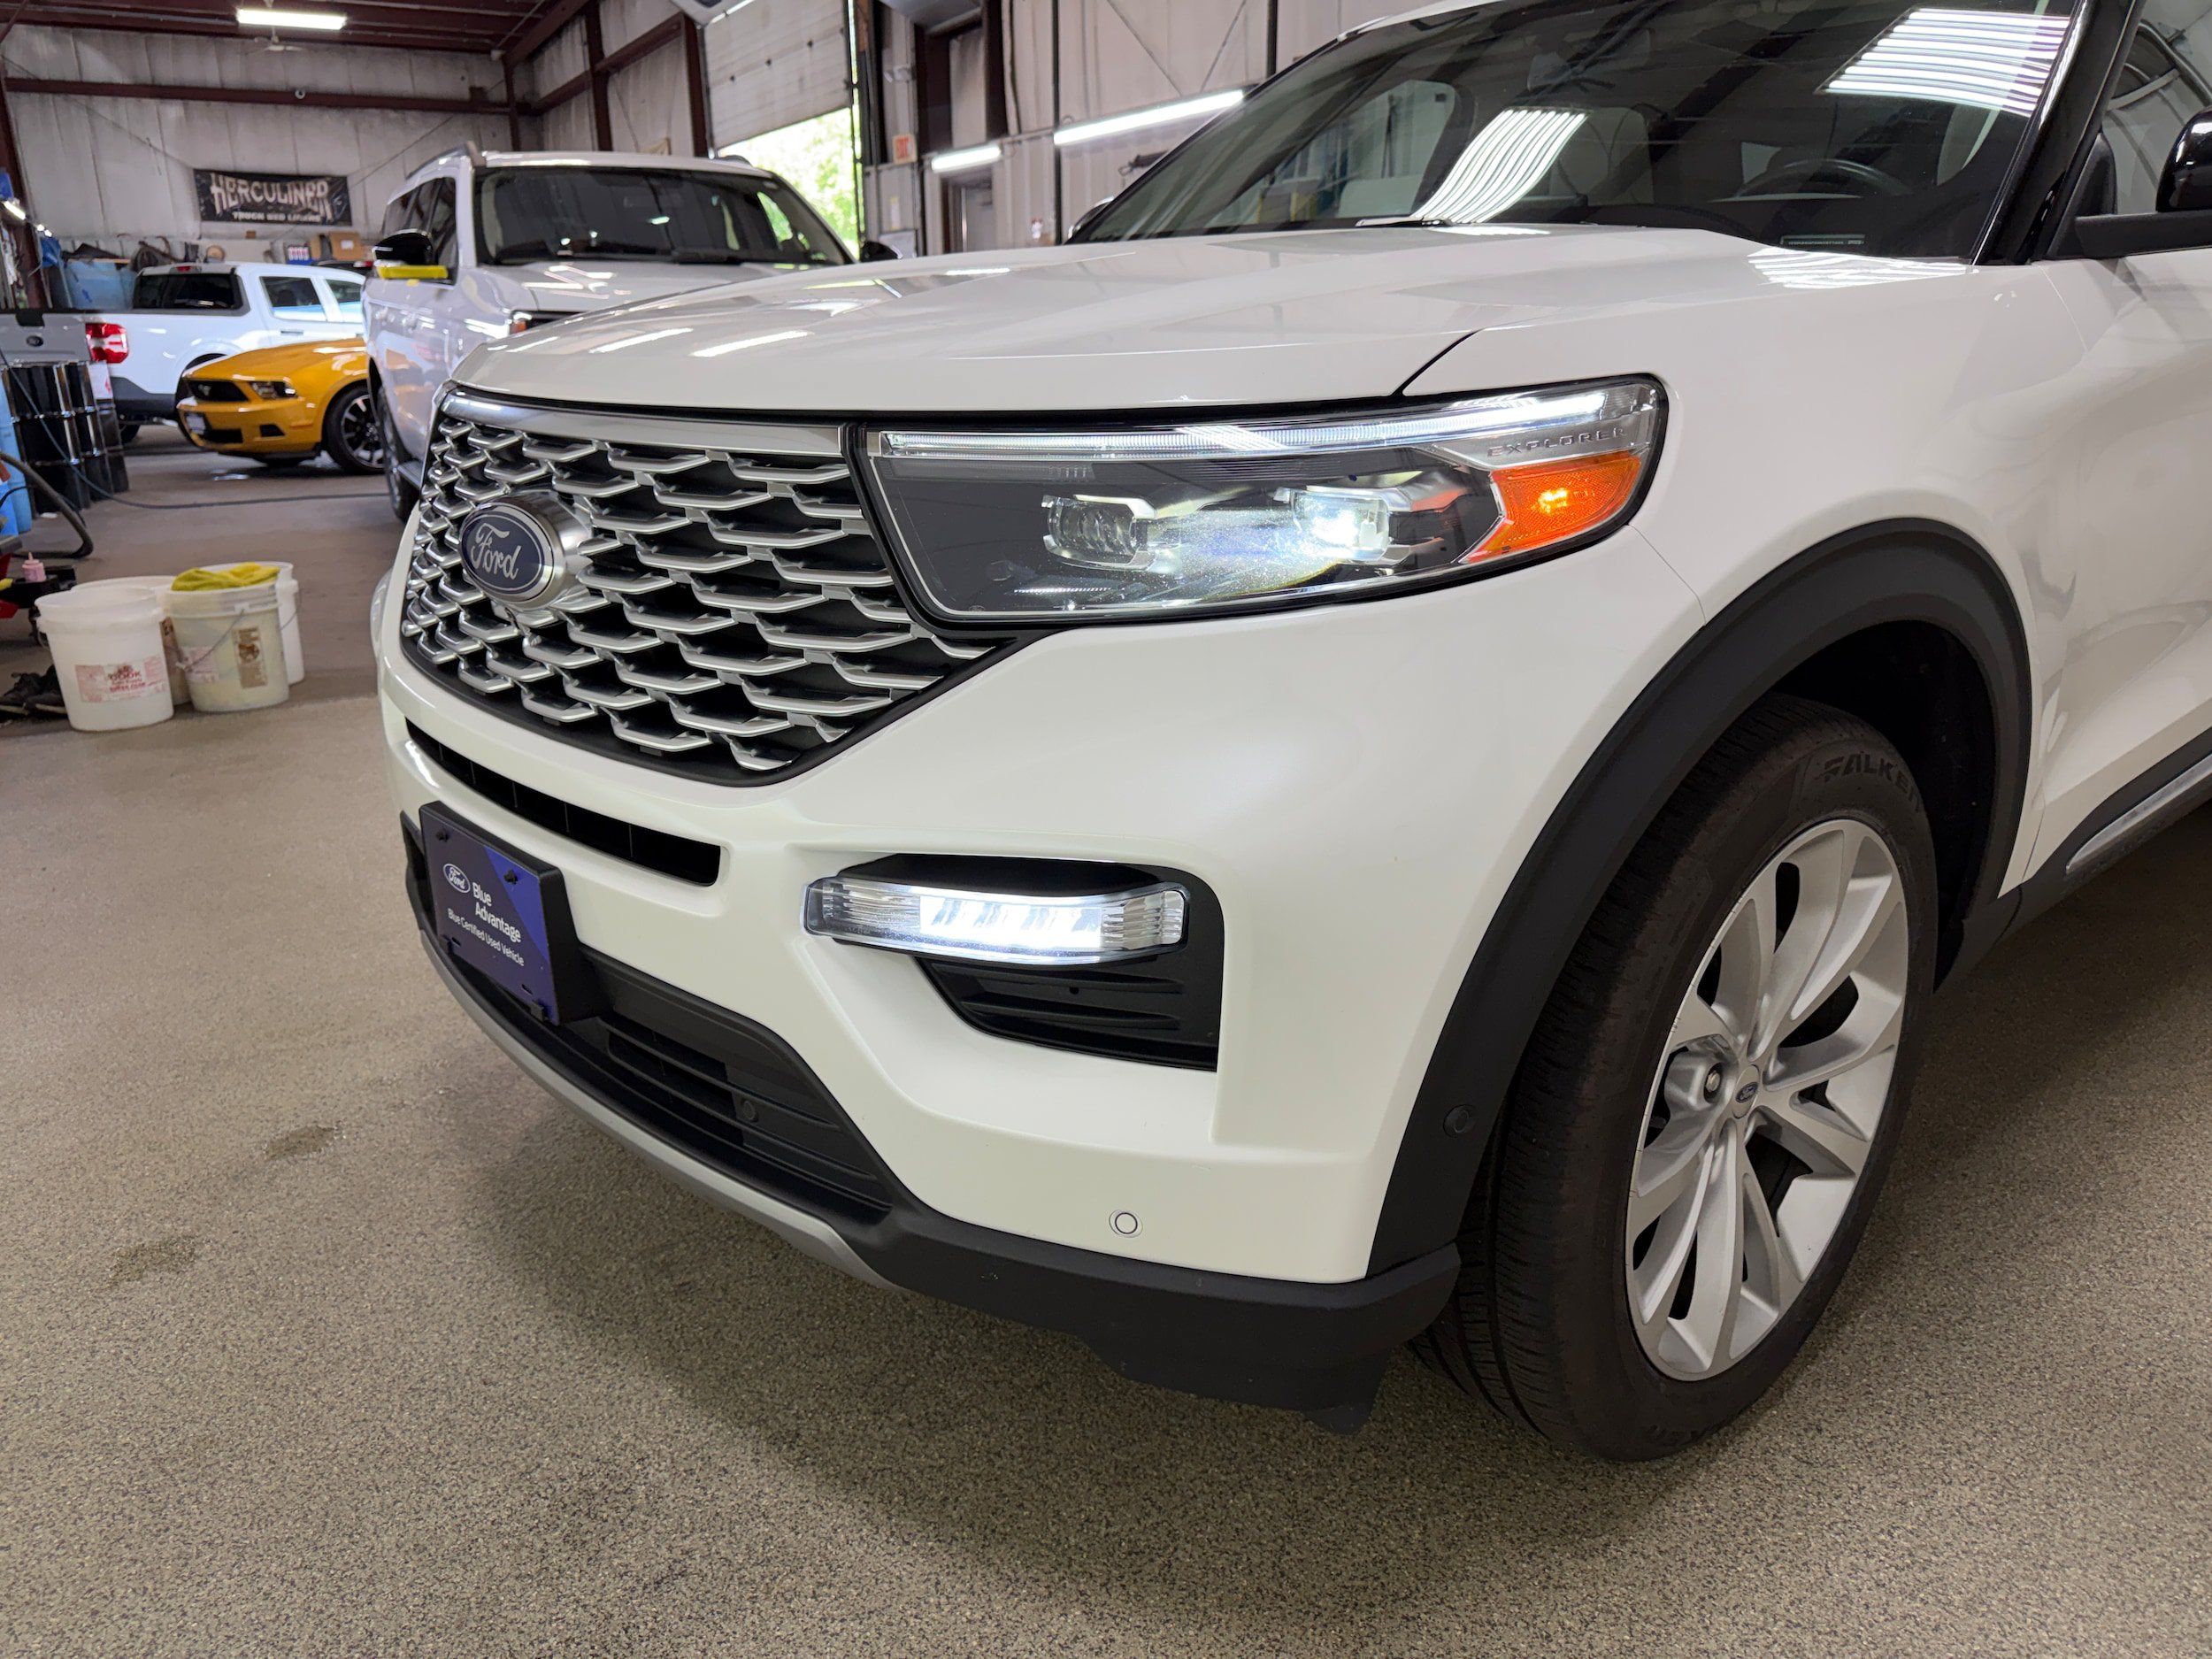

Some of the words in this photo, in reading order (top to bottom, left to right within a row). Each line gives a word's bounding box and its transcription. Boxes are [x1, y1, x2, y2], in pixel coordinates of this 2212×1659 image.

[211, 173, 334, 221] HERCULINER
[1487, 427, 1626, 456] EXPLORER
[471, 523, 521, 580] Ford
[472, 882, 492, 906] Blue
[448, 908, 461, 926] Blue
[460, 917, 485, 941] Certified
[485, 933, 502, 952] Used
[501, 943, 524, 966] Vehicle
[475, 902, 521, 942] Advantage
